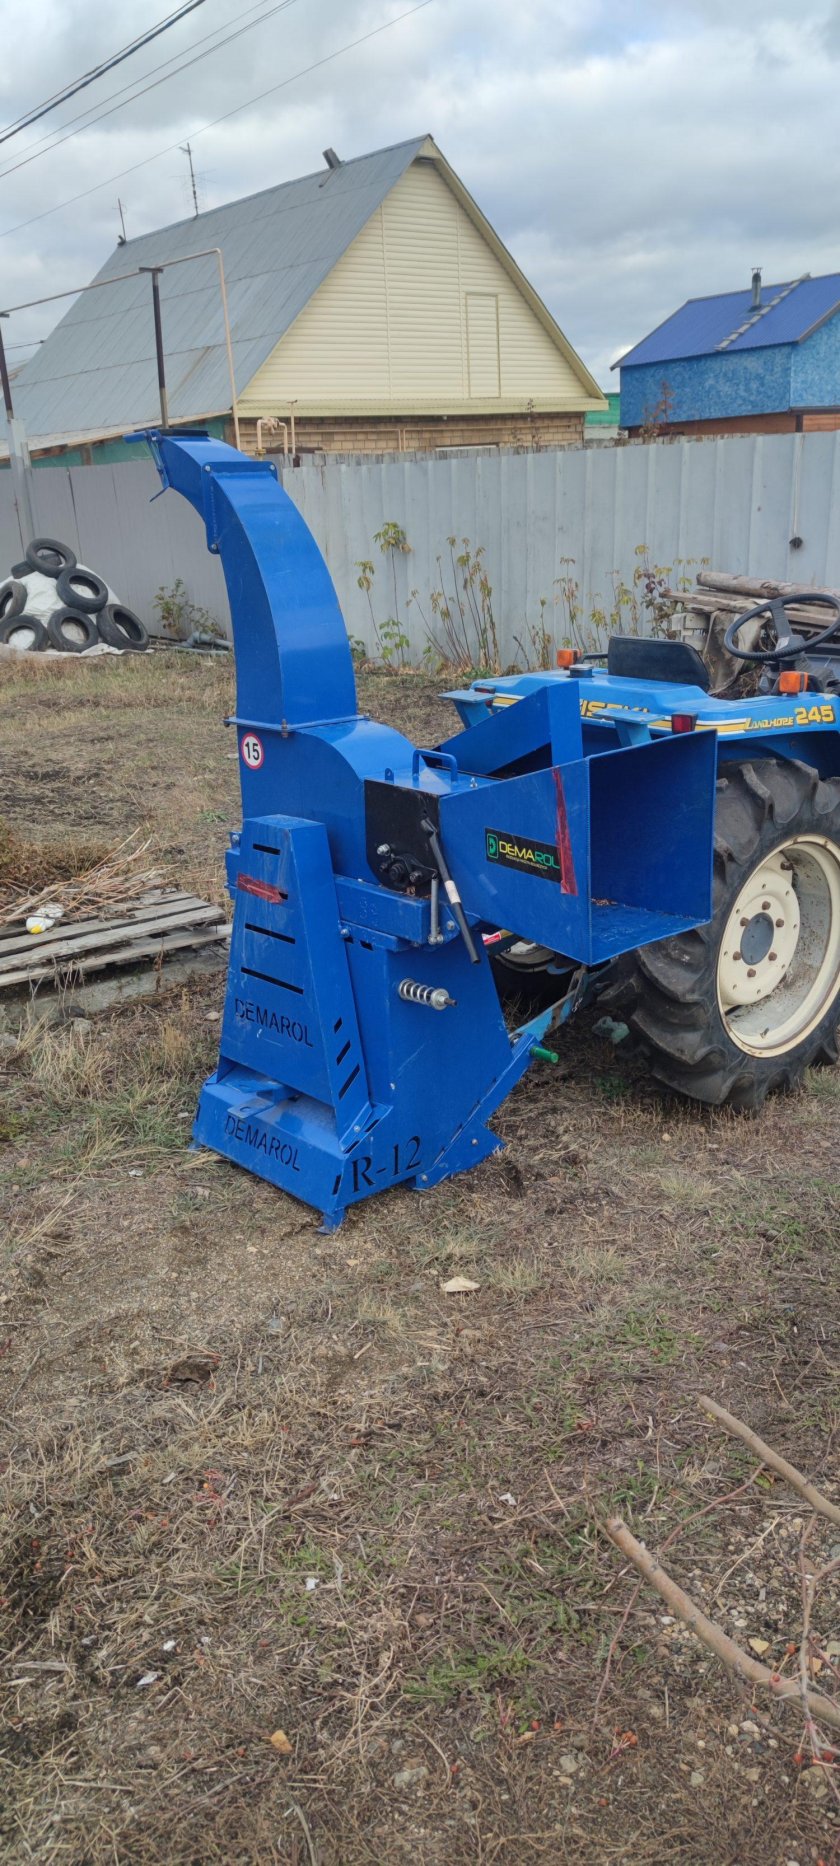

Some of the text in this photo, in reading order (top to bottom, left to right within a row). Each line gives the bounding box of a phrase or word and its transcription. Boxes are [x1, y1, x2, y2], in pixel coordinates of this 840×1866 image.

[794, 705, 835, 725] 245
[244, 741, 261, 761] 15
[499, 841, 560, 869] DEMAROL
[234, 999, 314, 1047] DEMAROL
[224, 1115, 300, 1171] DEMAROL
[351, 1135, 421, 1193] R-12
